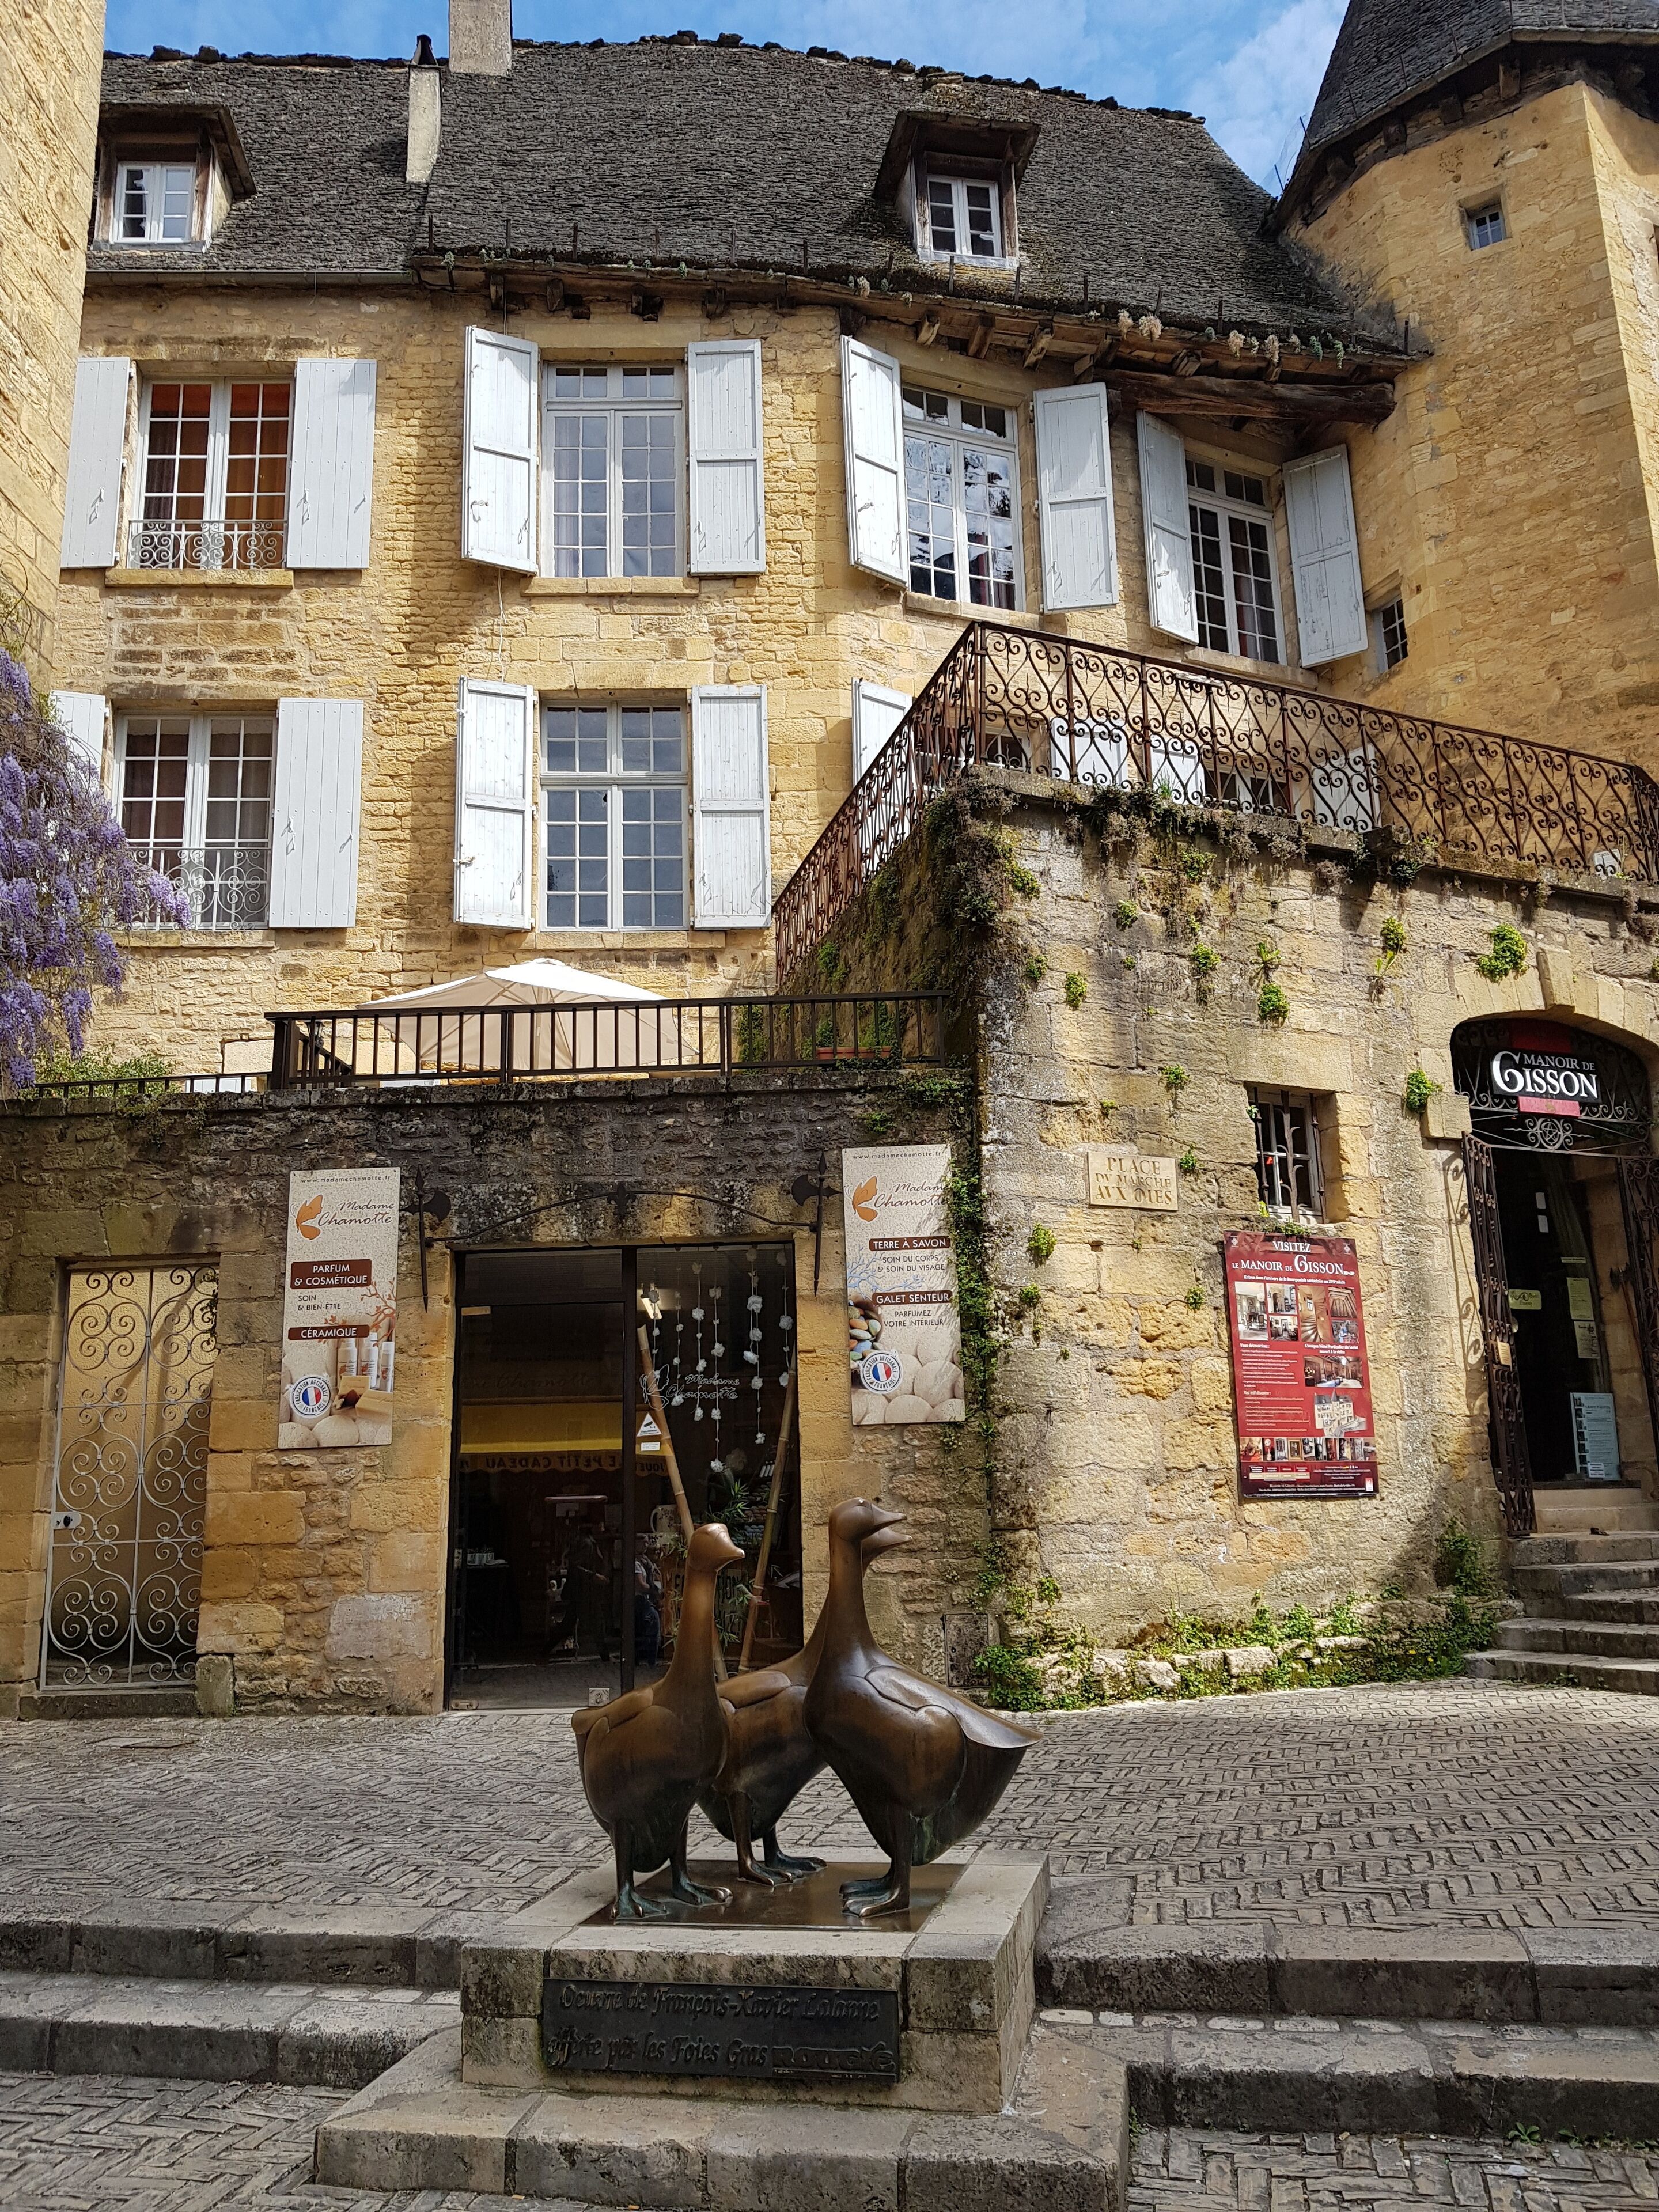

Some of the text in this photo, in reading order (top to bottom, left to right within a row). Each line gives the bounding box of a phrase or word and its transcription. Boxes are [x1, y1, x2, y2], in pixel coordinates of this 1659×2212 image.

[1523, 1053, 1596, 1071] MANOIR DE
[1493, 1051, 1598, 1099] GISSON
[1107, 1157, 1160, 1176] PLACE
[301, 1175, 391, 1183] www.madamechamotte.fr
[1116, 1175, 1171, 1188] MARCHÉ
[893, 1181, 948, 1193] Madam
[1134, 1188, 1172, 1205] OIES
[338, 1199, 395, 1211] Madame
[317, 1211, 392, 1226] Chamotte
[873, 1238, 946, 1249] TERRE À SAVON
[1272, 1240, 1311, 1253] VISITEZ
[313, 1264, 350, 1273] PARFUM
[1240, 1259, 1283, 1271] MANOIR
[1294, 1254, 1344, 1275] GISSON
[294, 1274, 368, 1286] & COSMÉTIQUE
[876, 1293, 949, 1304] GALET SENTEUR
[301, 1327, 357, 1338] CÉRAMIQUE
[627, 1983, 649, 2009] de
[802, 1990, 880, 2021] Lalanne
[605, 2036, 638, 2069] par
[642, 2031, 667, 2061] les
[671, 2035, 720, 2062] Foies
[728, 2038, 768, 2068] Gras
